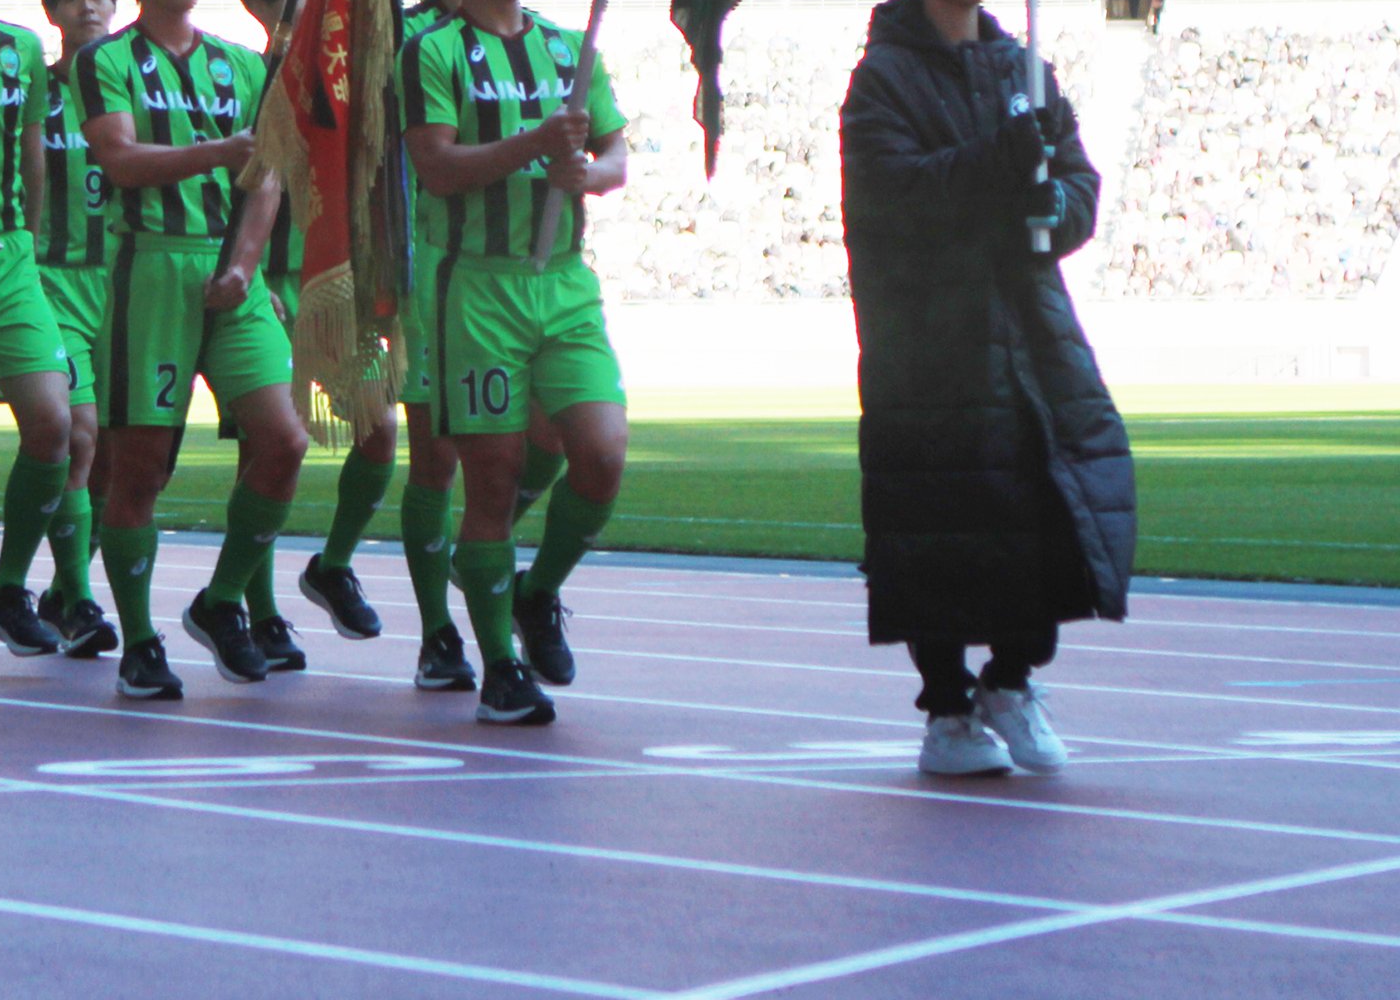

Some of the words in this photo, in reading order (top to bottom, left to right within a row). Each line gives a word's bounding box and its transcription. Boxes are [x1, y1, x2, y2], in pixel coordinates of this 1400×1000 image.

[468, 78, 576, 102] MINAM
[84, 169, 108, 210] 9
[155, 362, 178, 409] 2
[460, 366, 511, 416] 10
